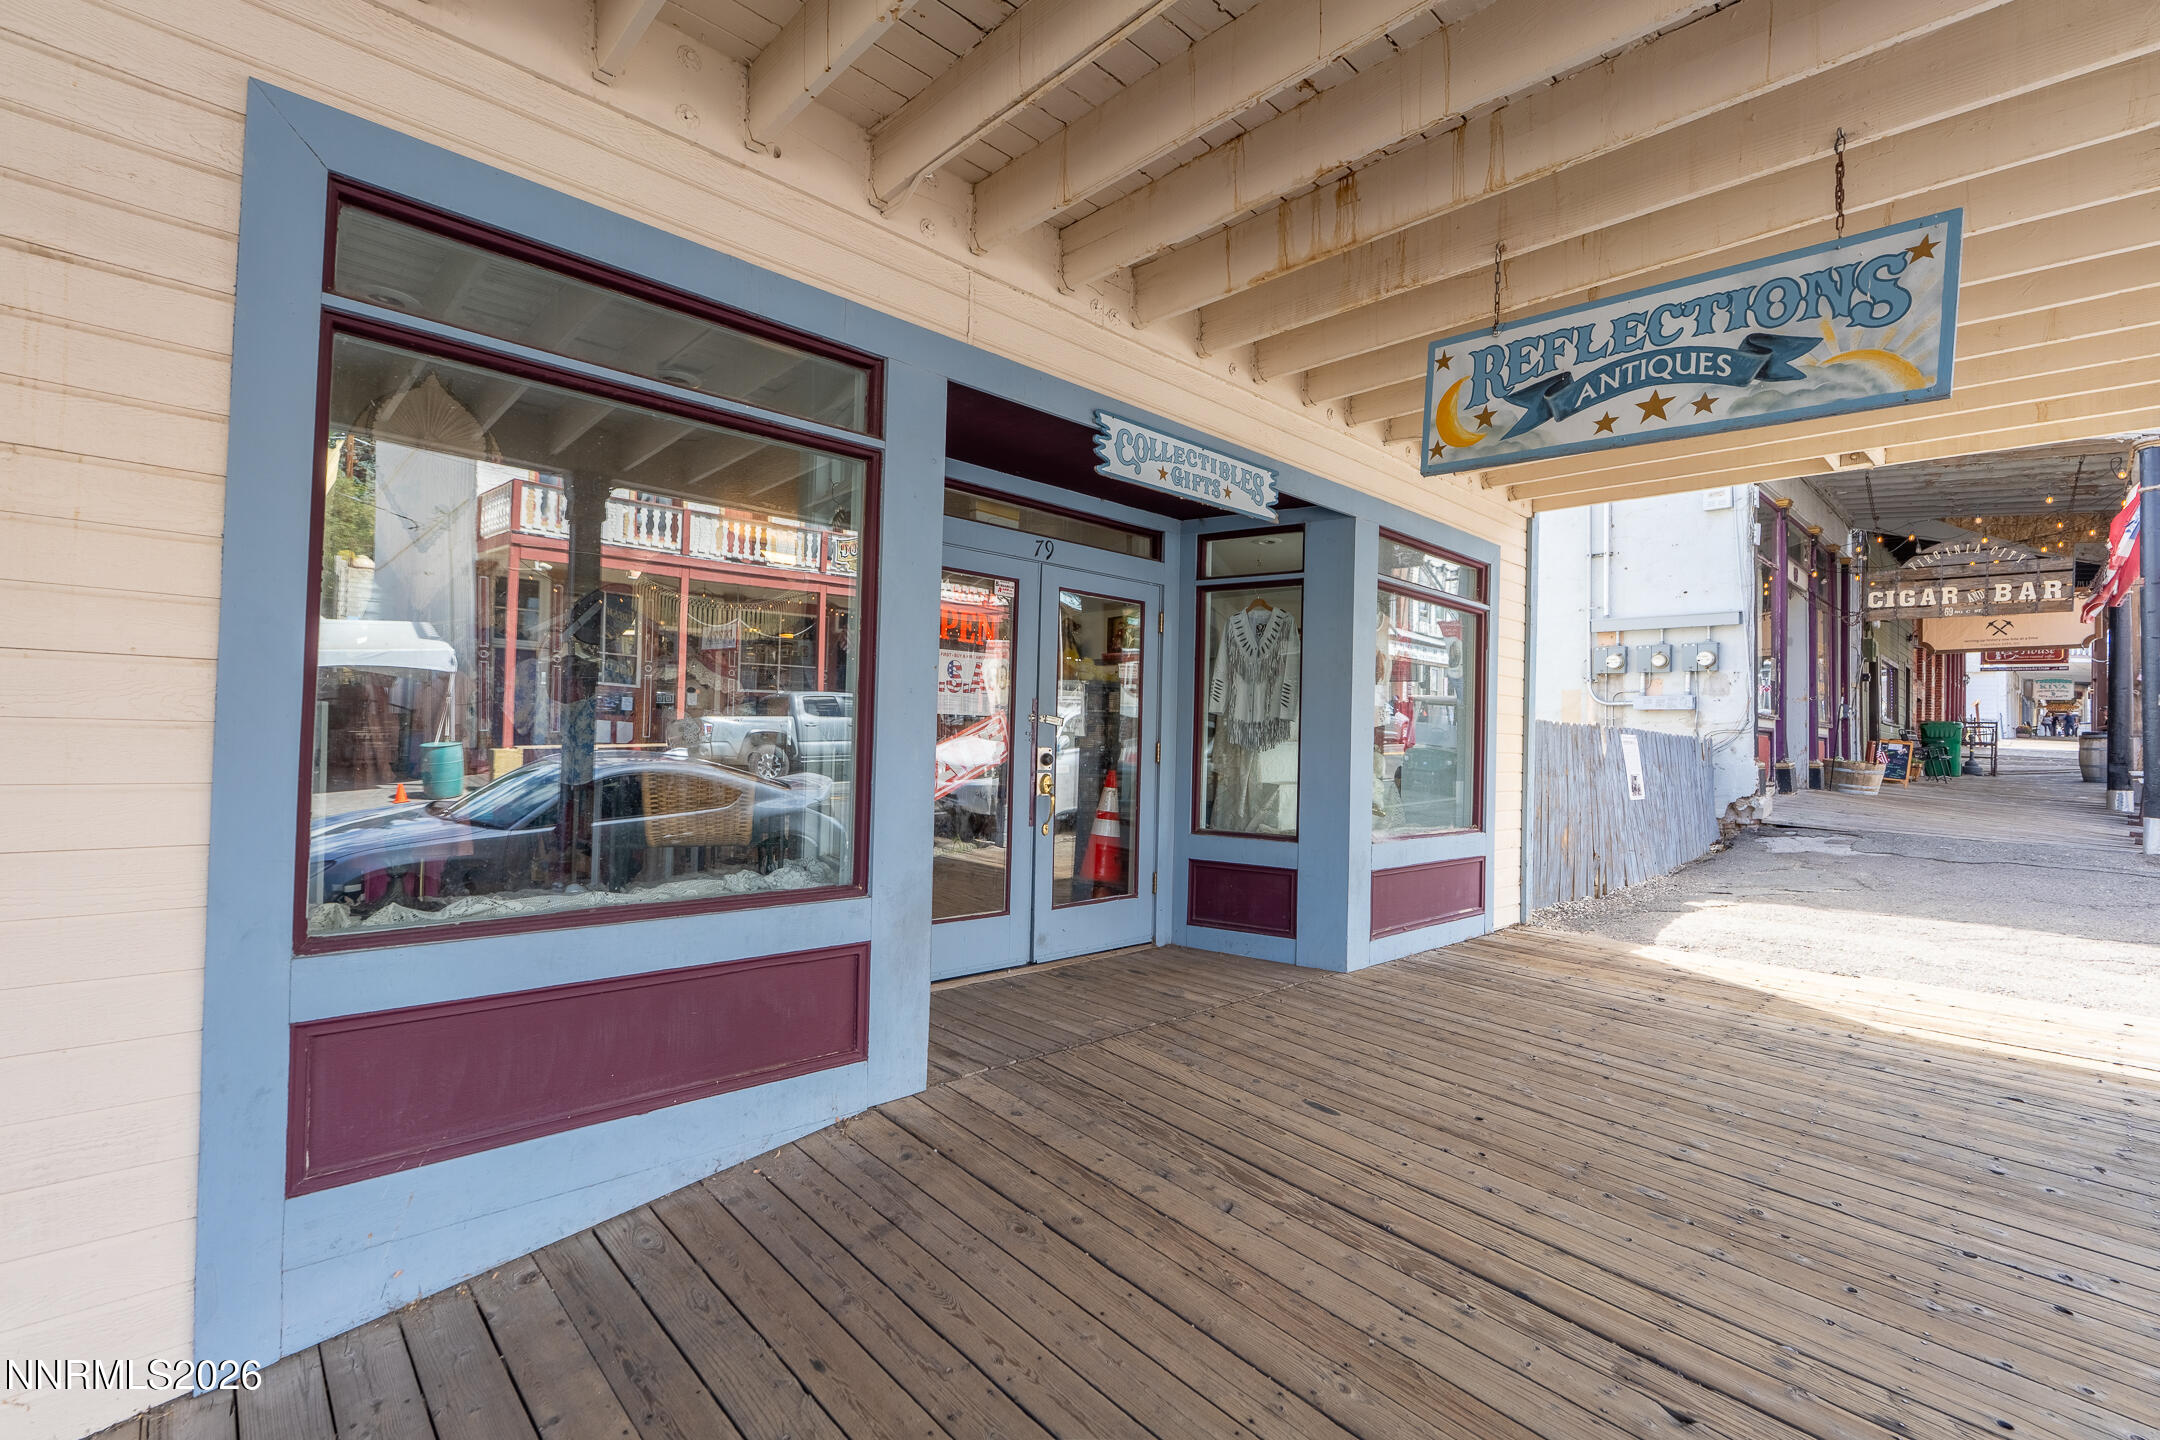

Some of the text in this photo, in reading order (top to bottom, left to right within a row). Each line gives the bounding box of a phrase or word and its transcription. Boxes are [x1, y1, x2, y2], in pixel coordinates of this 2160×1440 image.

[1464, 250, 1915, 410] REFLECTIONS
[1577, 352, 1732, 405] ANTIQUES
[1114, 428, 1265, 507] COLLECTIBLES
[1170, 467, 1221, 500] GIFTS
[1034, 539, 1055, 561] 79
[1908, 543, 2028, 571] VIRGINIA CITY
[1868, 580, 2062, 608] CIGAR AND BAR
[940, 608, 995, 646] PEN
